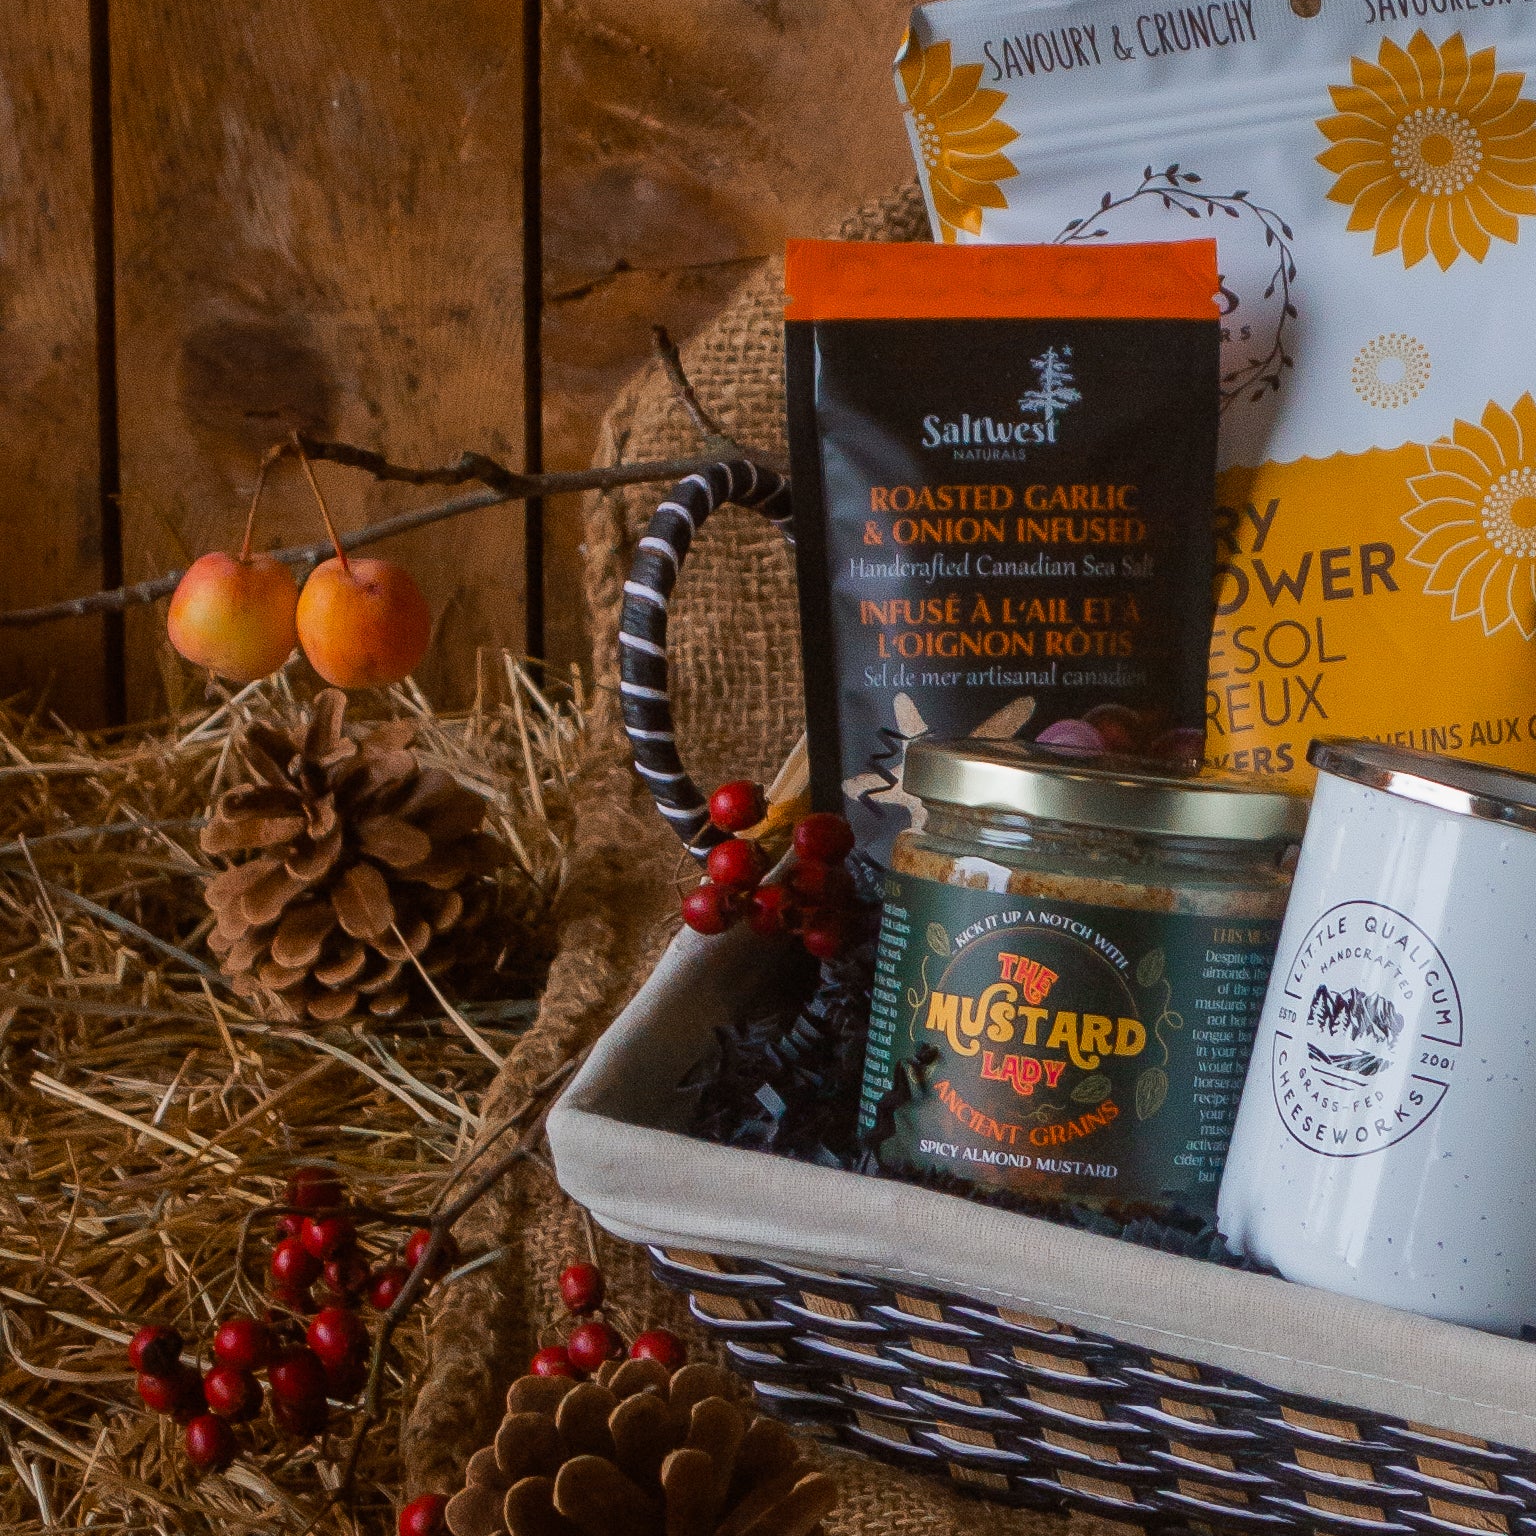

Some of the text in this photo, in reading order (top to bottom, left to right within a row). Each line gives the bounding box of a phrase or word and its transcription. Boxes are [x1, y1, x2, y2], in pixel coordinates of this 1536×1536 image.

[983, 24, 1102, 81] SAVOURY
[1112, 24, 1136, 61] &
[952, 448, 1027, 462] NATURALS
[869, 484, 1140, 513] ROASTED GARLIC
[862, 516, 1147, 546] & ONION INFUSED
[849, 552, 970, 584] Handcrafted
[975, 551, 1076, 577] Canadian
[1082, 554, 1116, 577] Sea
[1215, 541, 1401, 616] OWER
[858, 592, 960, 626] INFUSÉ
[970, 592, 993, 626] À
[1002, 596, 1074, 624] L'AIL
[1082, 597, 1112, 624] ET
[878, 626, 1133, 659] L'OIGNON RÔTIS
[1208, 617, 1348, 681] ESOL
[862, 661, 1148, 688] Sel de mer artisanal canadien
[1206, 672, 1329, 737] REUX
[1469, 716, 1522, 749] AUX
[954, 910, 1129, 970] KICK IT UP A NOTCH WITH
[997, 951, 1060, 1006] THE
[1294, 916, 1453, 1026] LITTLE QUALICUM
[1320, 947, 1414, 1001] HANDCRAFTED
[925, 981, 1148, 1070] MUSTARD
[1278, 1006, 1297, 1023] ESTD
[980, 1050, 1067, 1096] LADY
[1420, 1051, 1455, 1071] 2001
[933, 1079, 1121, 1147] ANCIENT GRAINS
[1278, 1050, 1425, 1145] CHEESEWORKS
[1299, 1067, 1385, 1113] GRASS-FED
[919, 1139, 1119, 1178] SPICY ALMOND MUSTARD
